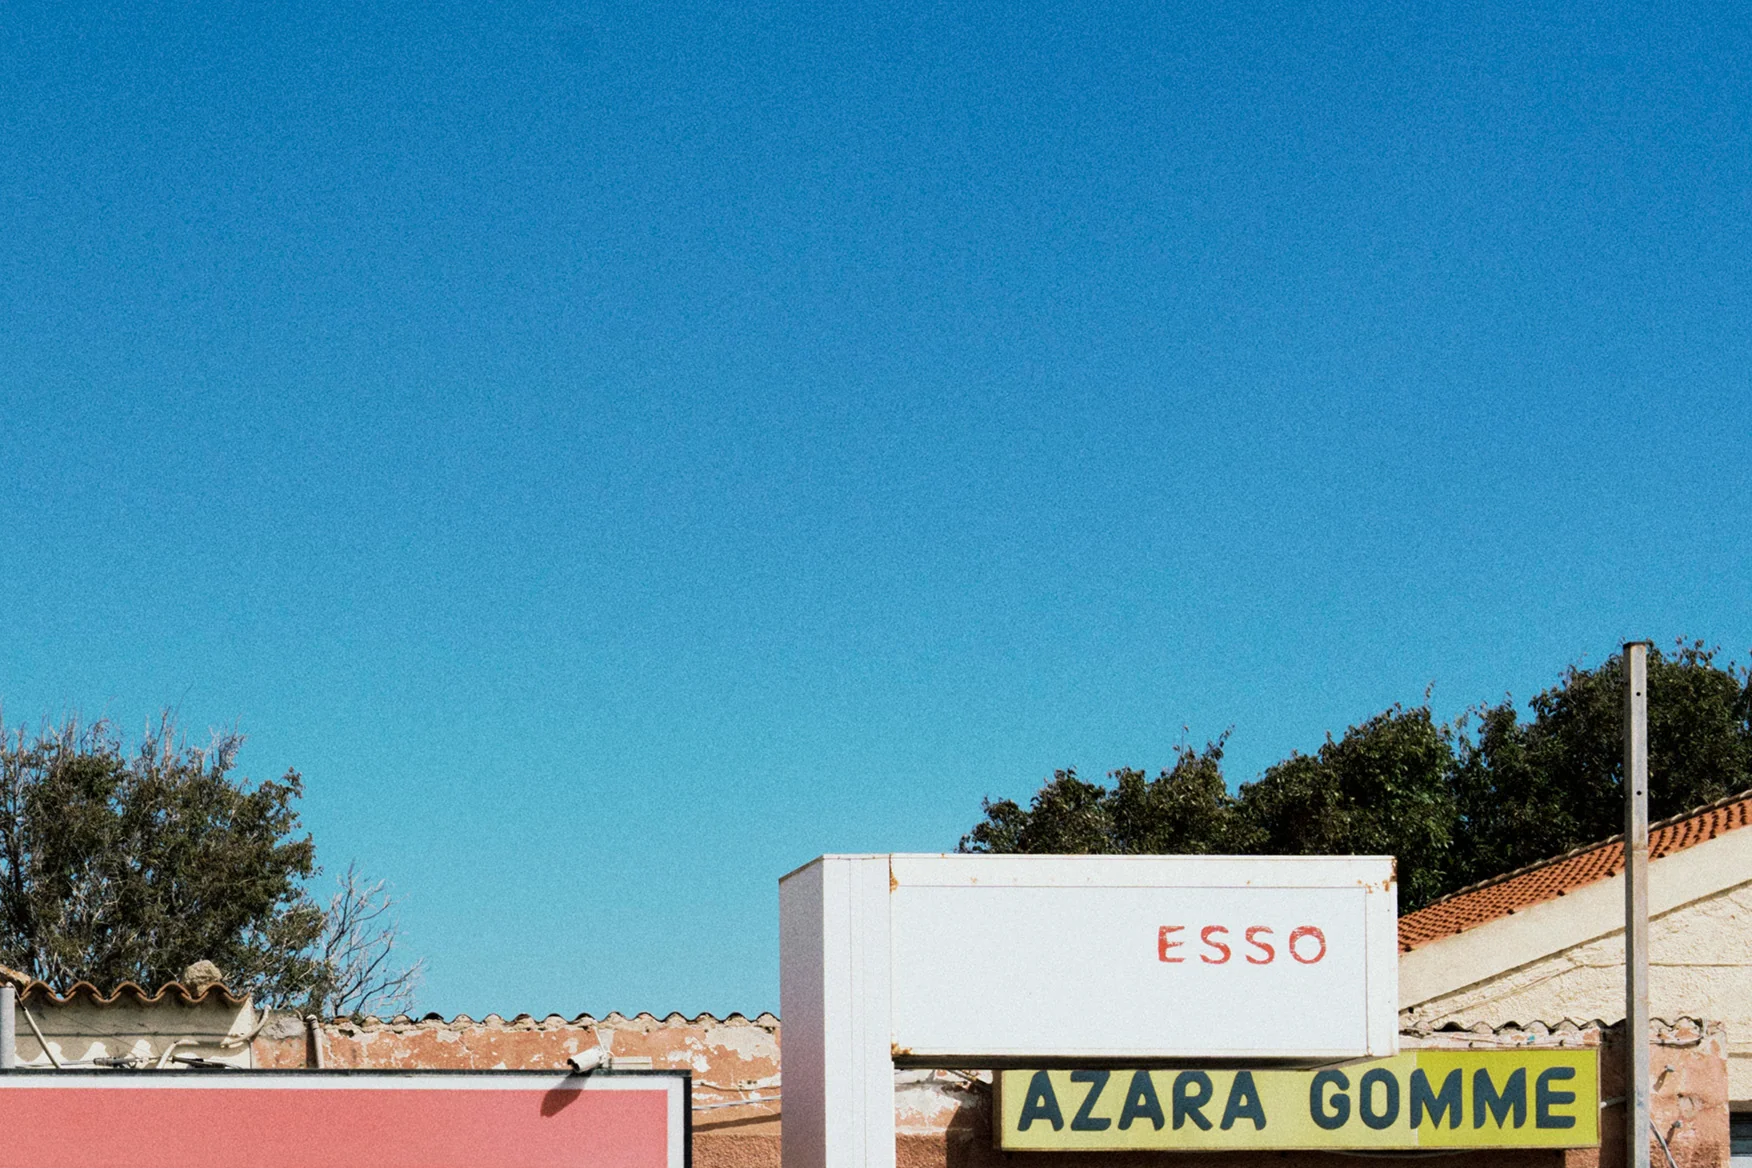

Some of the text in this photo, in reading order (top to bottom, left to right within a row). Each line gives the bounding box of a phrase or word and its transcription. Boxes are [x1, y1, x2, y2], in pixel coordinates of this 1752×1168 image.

[1158, 925, 1327, 965] ESSO
[1017, 1066, 1577, 1132] AZARA GOMME
